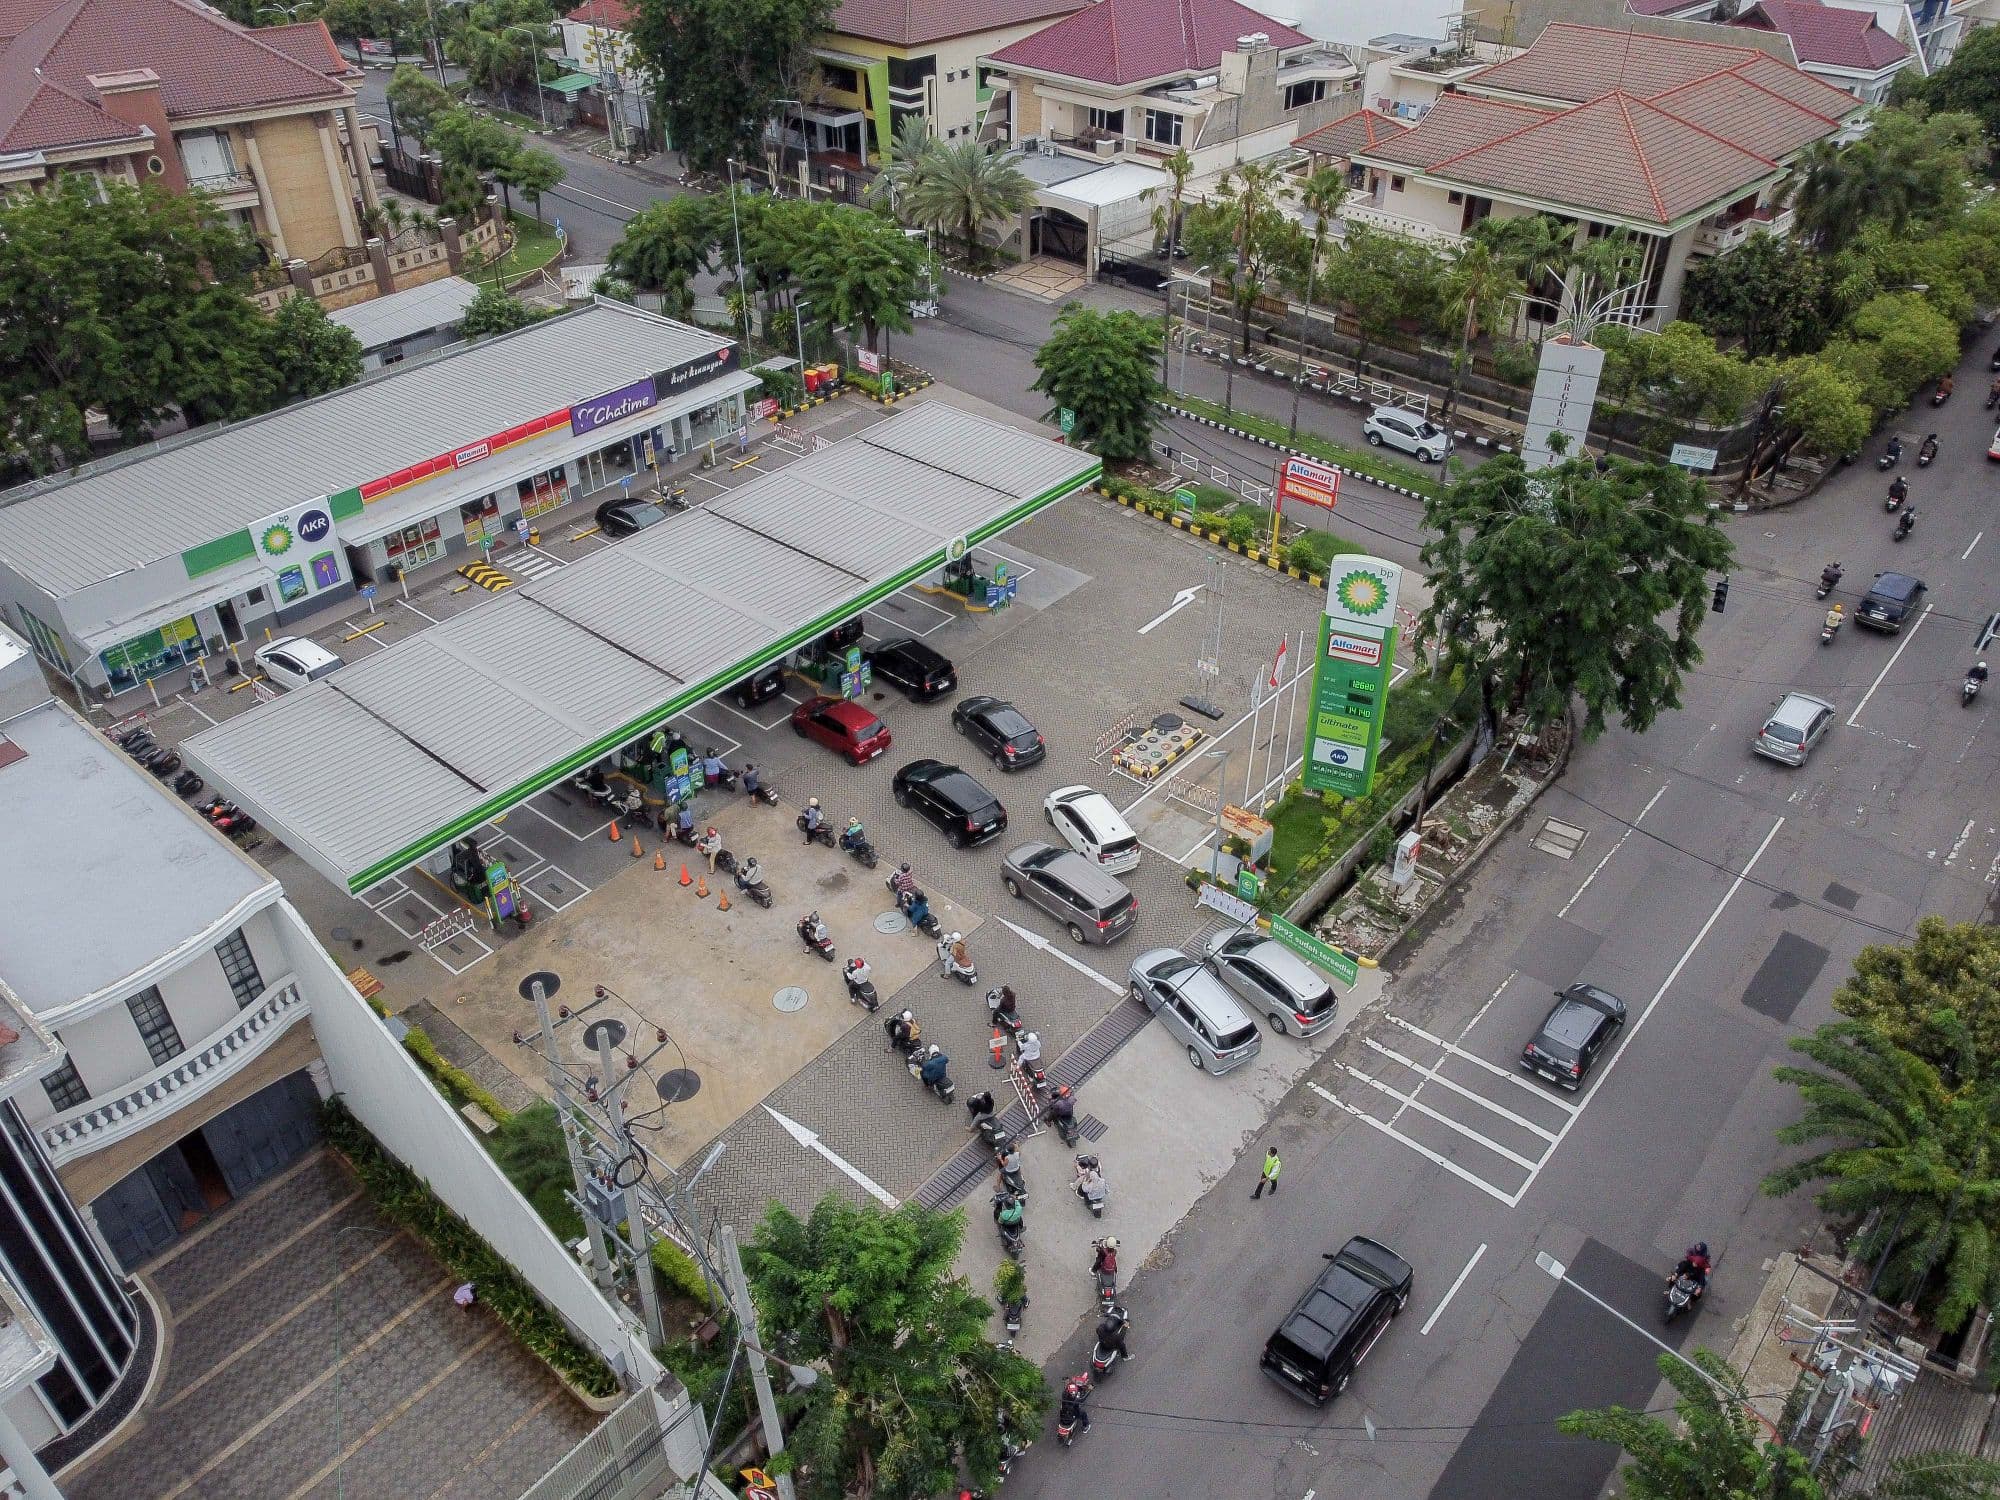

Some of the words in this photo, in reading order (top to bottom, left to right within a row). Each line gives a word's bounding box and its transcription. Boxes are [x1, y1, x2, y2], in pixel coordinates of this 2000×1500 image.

[593, 395, 650, 425] Chatime
[457, 445, 488, 461] Alfamart
[1290, 463, 1333, 484] Alfamart
[278, 514, 290, 523] bp
[301, 517, 327, 535] AKR
[1380, 568, 1394, 579] bp
[1331, 639, 1378, 655] Alfamart
[1320, 717, 1359, 731] ultimate
[1273, 922, 1294, 939] BP92
[1295, 937, 1318, 955] sudah
[1319, 951, 1354, 977] tersedia!
